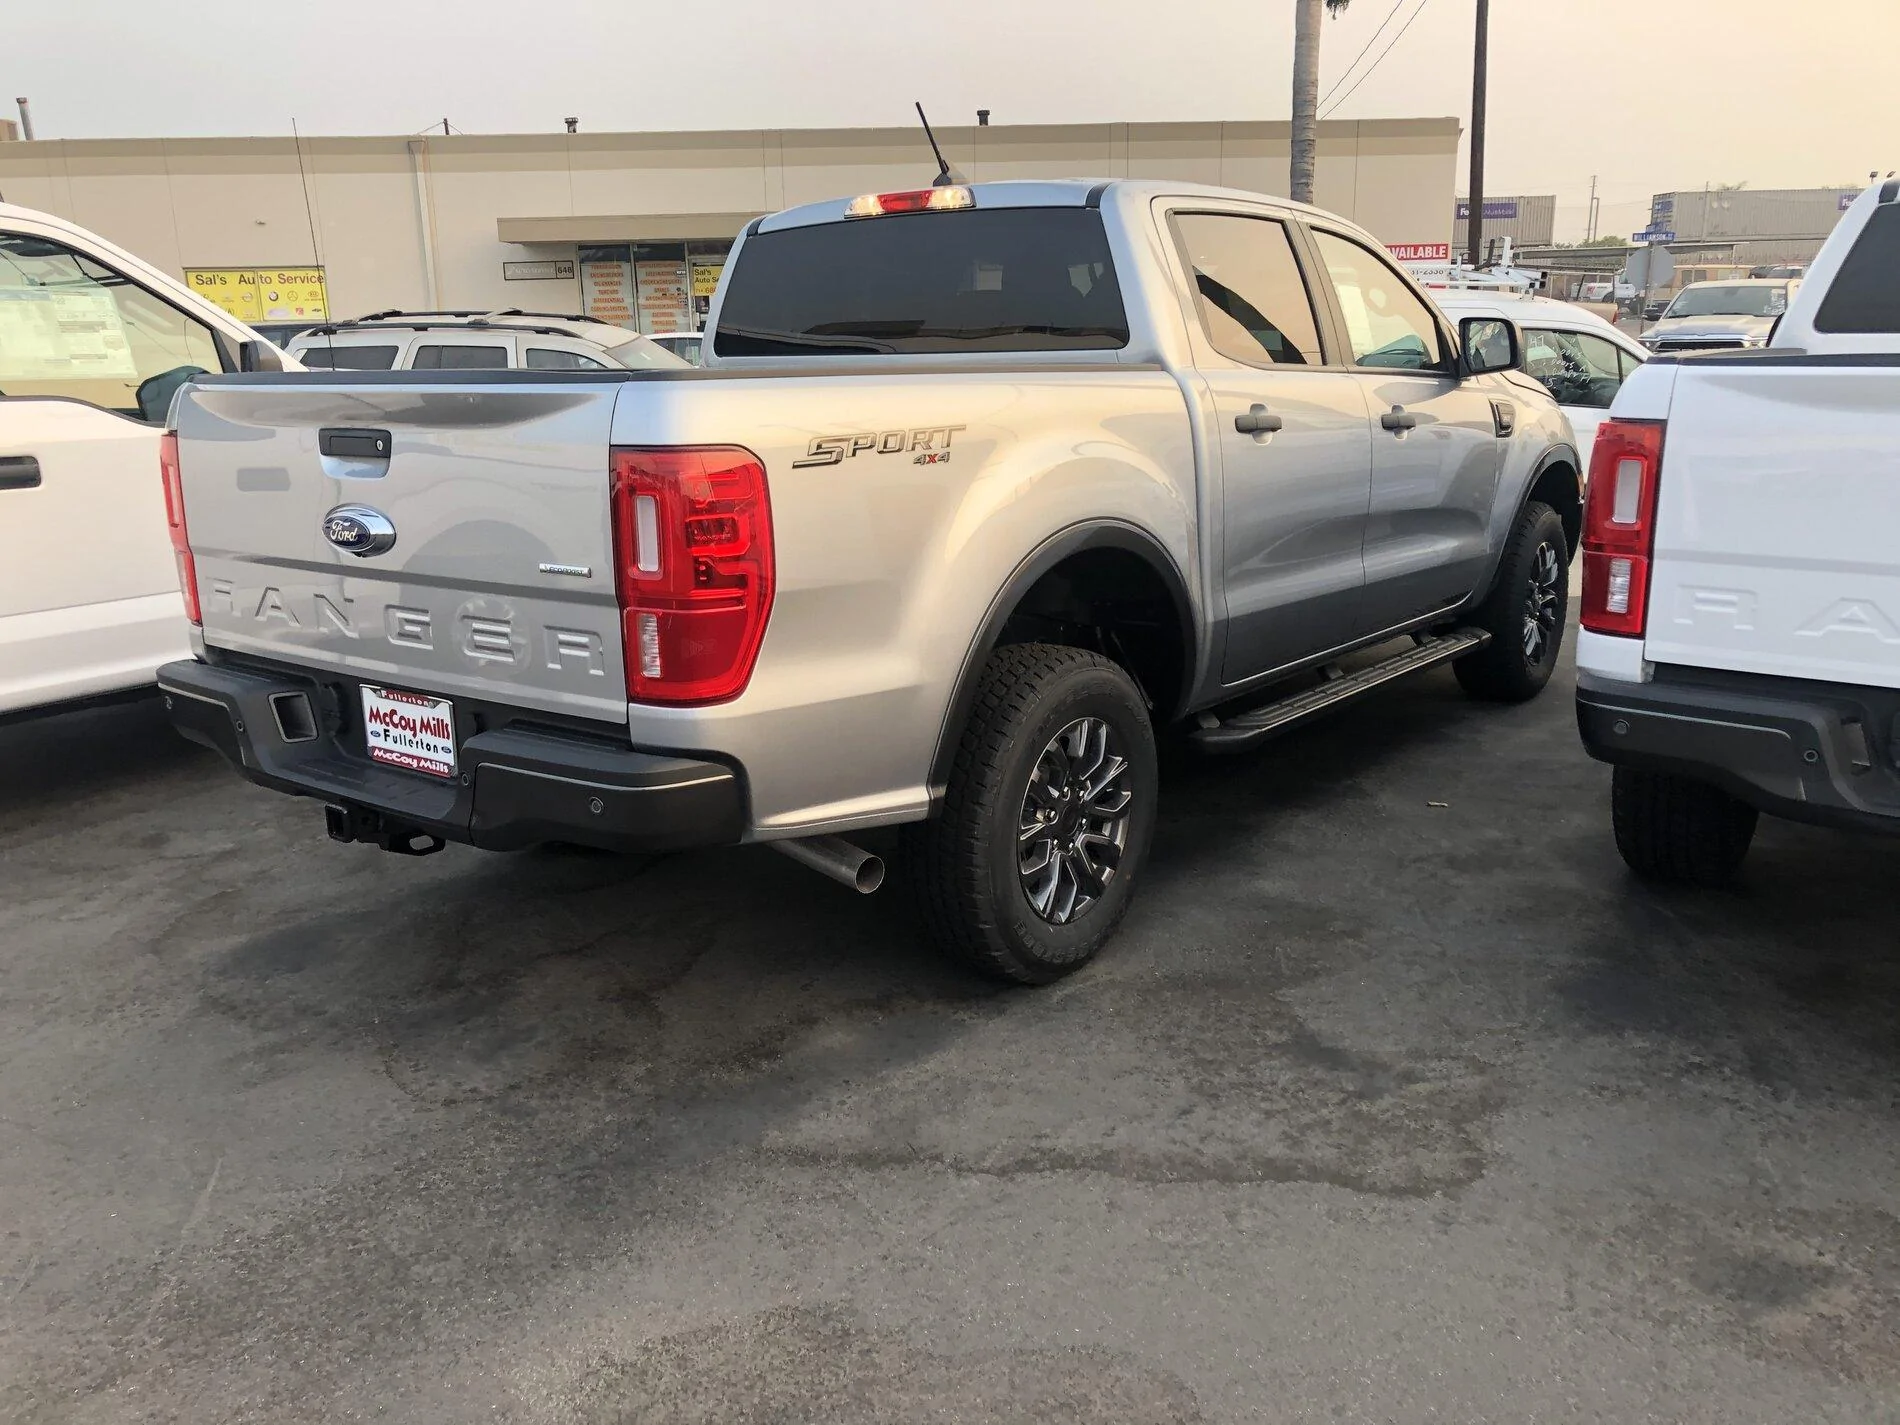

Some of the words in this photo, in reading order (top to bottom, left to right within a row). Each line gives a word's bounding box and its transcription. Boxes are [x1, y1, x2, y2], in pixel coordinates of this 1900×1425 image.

[195, 274, 227, 286] Sal's
[238, 273, 272, 285] Auto
[277, 273, 324, 285] Service
[694, 268, 712, 276] Sal's
[792, 425, 967, 469] SPORT
[330, 520, 358, 542] Ford
[205, 577, 605, 677] RANGER
[380, 690, 429, 707] Fullerton
[368, 705, 417, 739] McCoy
[419, 715, 451, 741] Mills
[383, 728, 439, 754] Fullerton
[373, 748, 418, 768] McCoy
[419, 758, 449, 774] Mills
